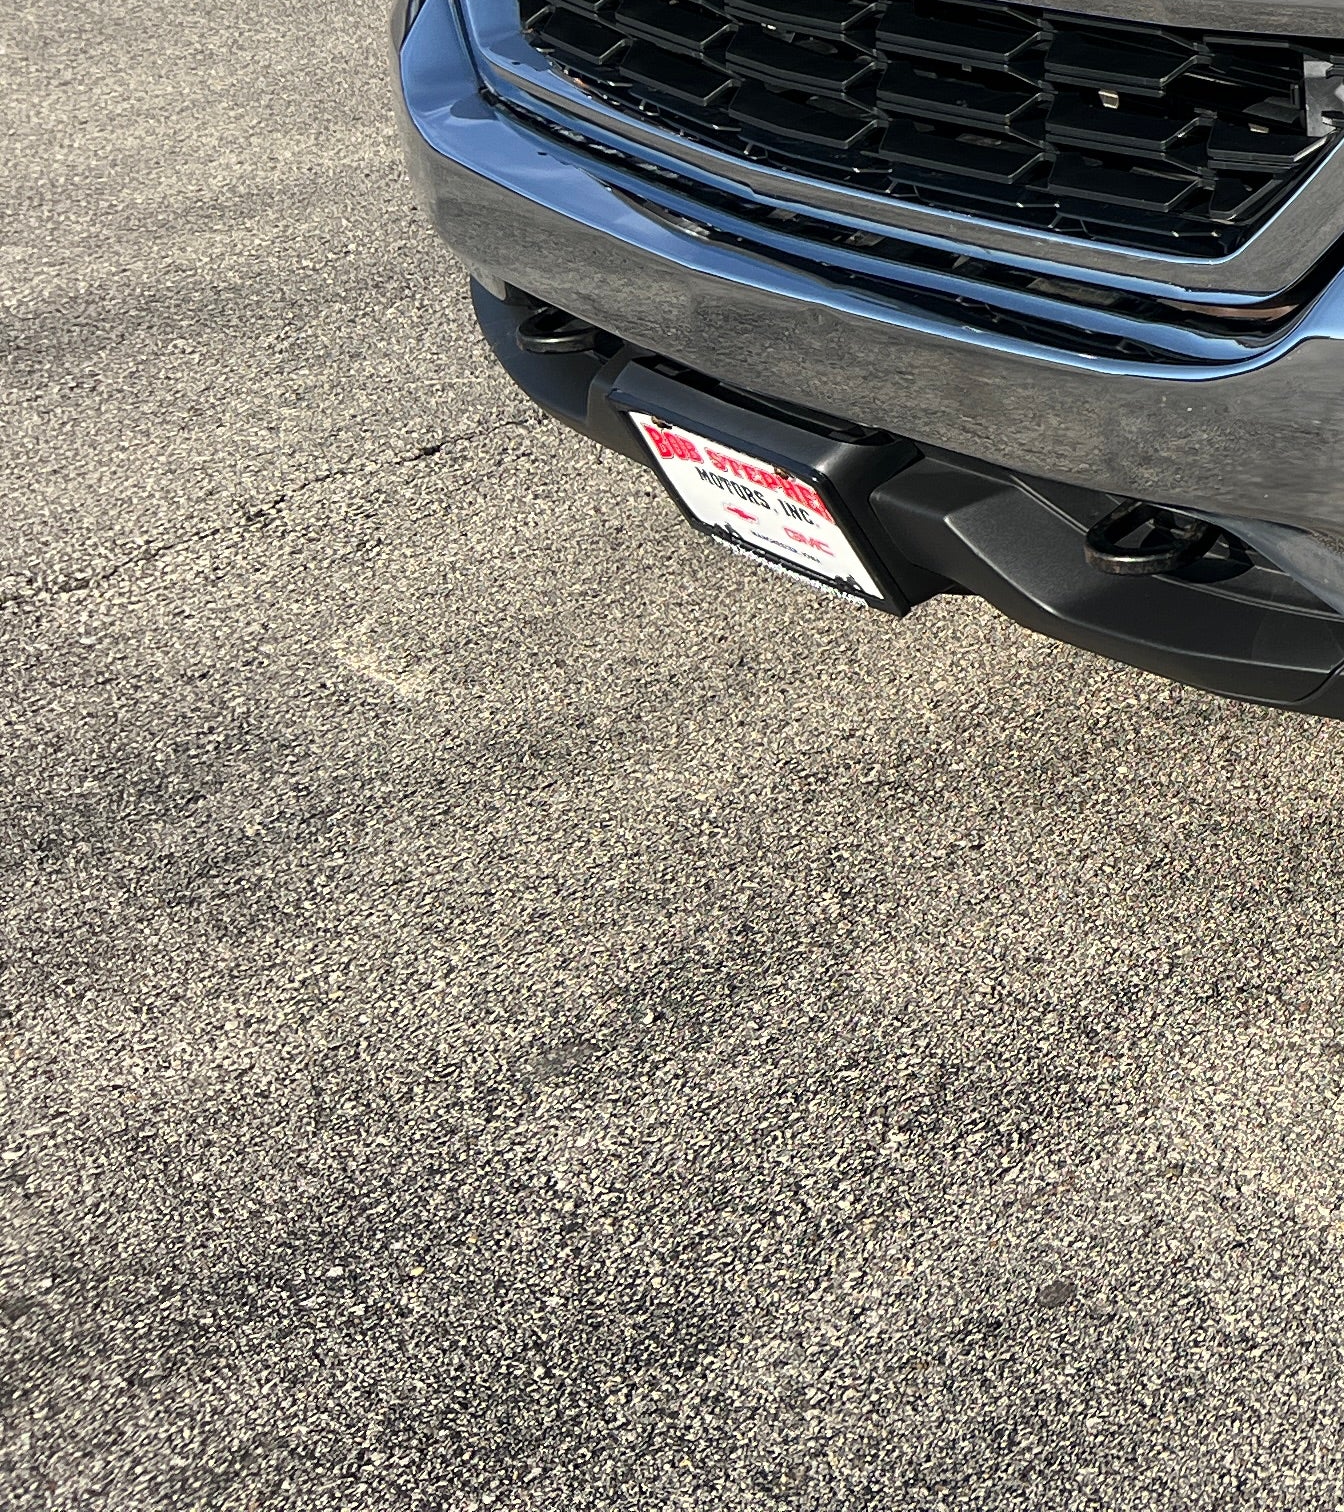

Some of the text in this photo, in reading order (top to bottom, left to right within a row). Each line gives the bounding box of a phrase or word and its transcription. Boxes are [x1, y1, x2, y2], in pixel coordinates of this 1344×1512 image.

[642, 422, 704, 465] BOB
[777, 498, 821, 528] INC.
[782, 525, 835, 557] GMC
